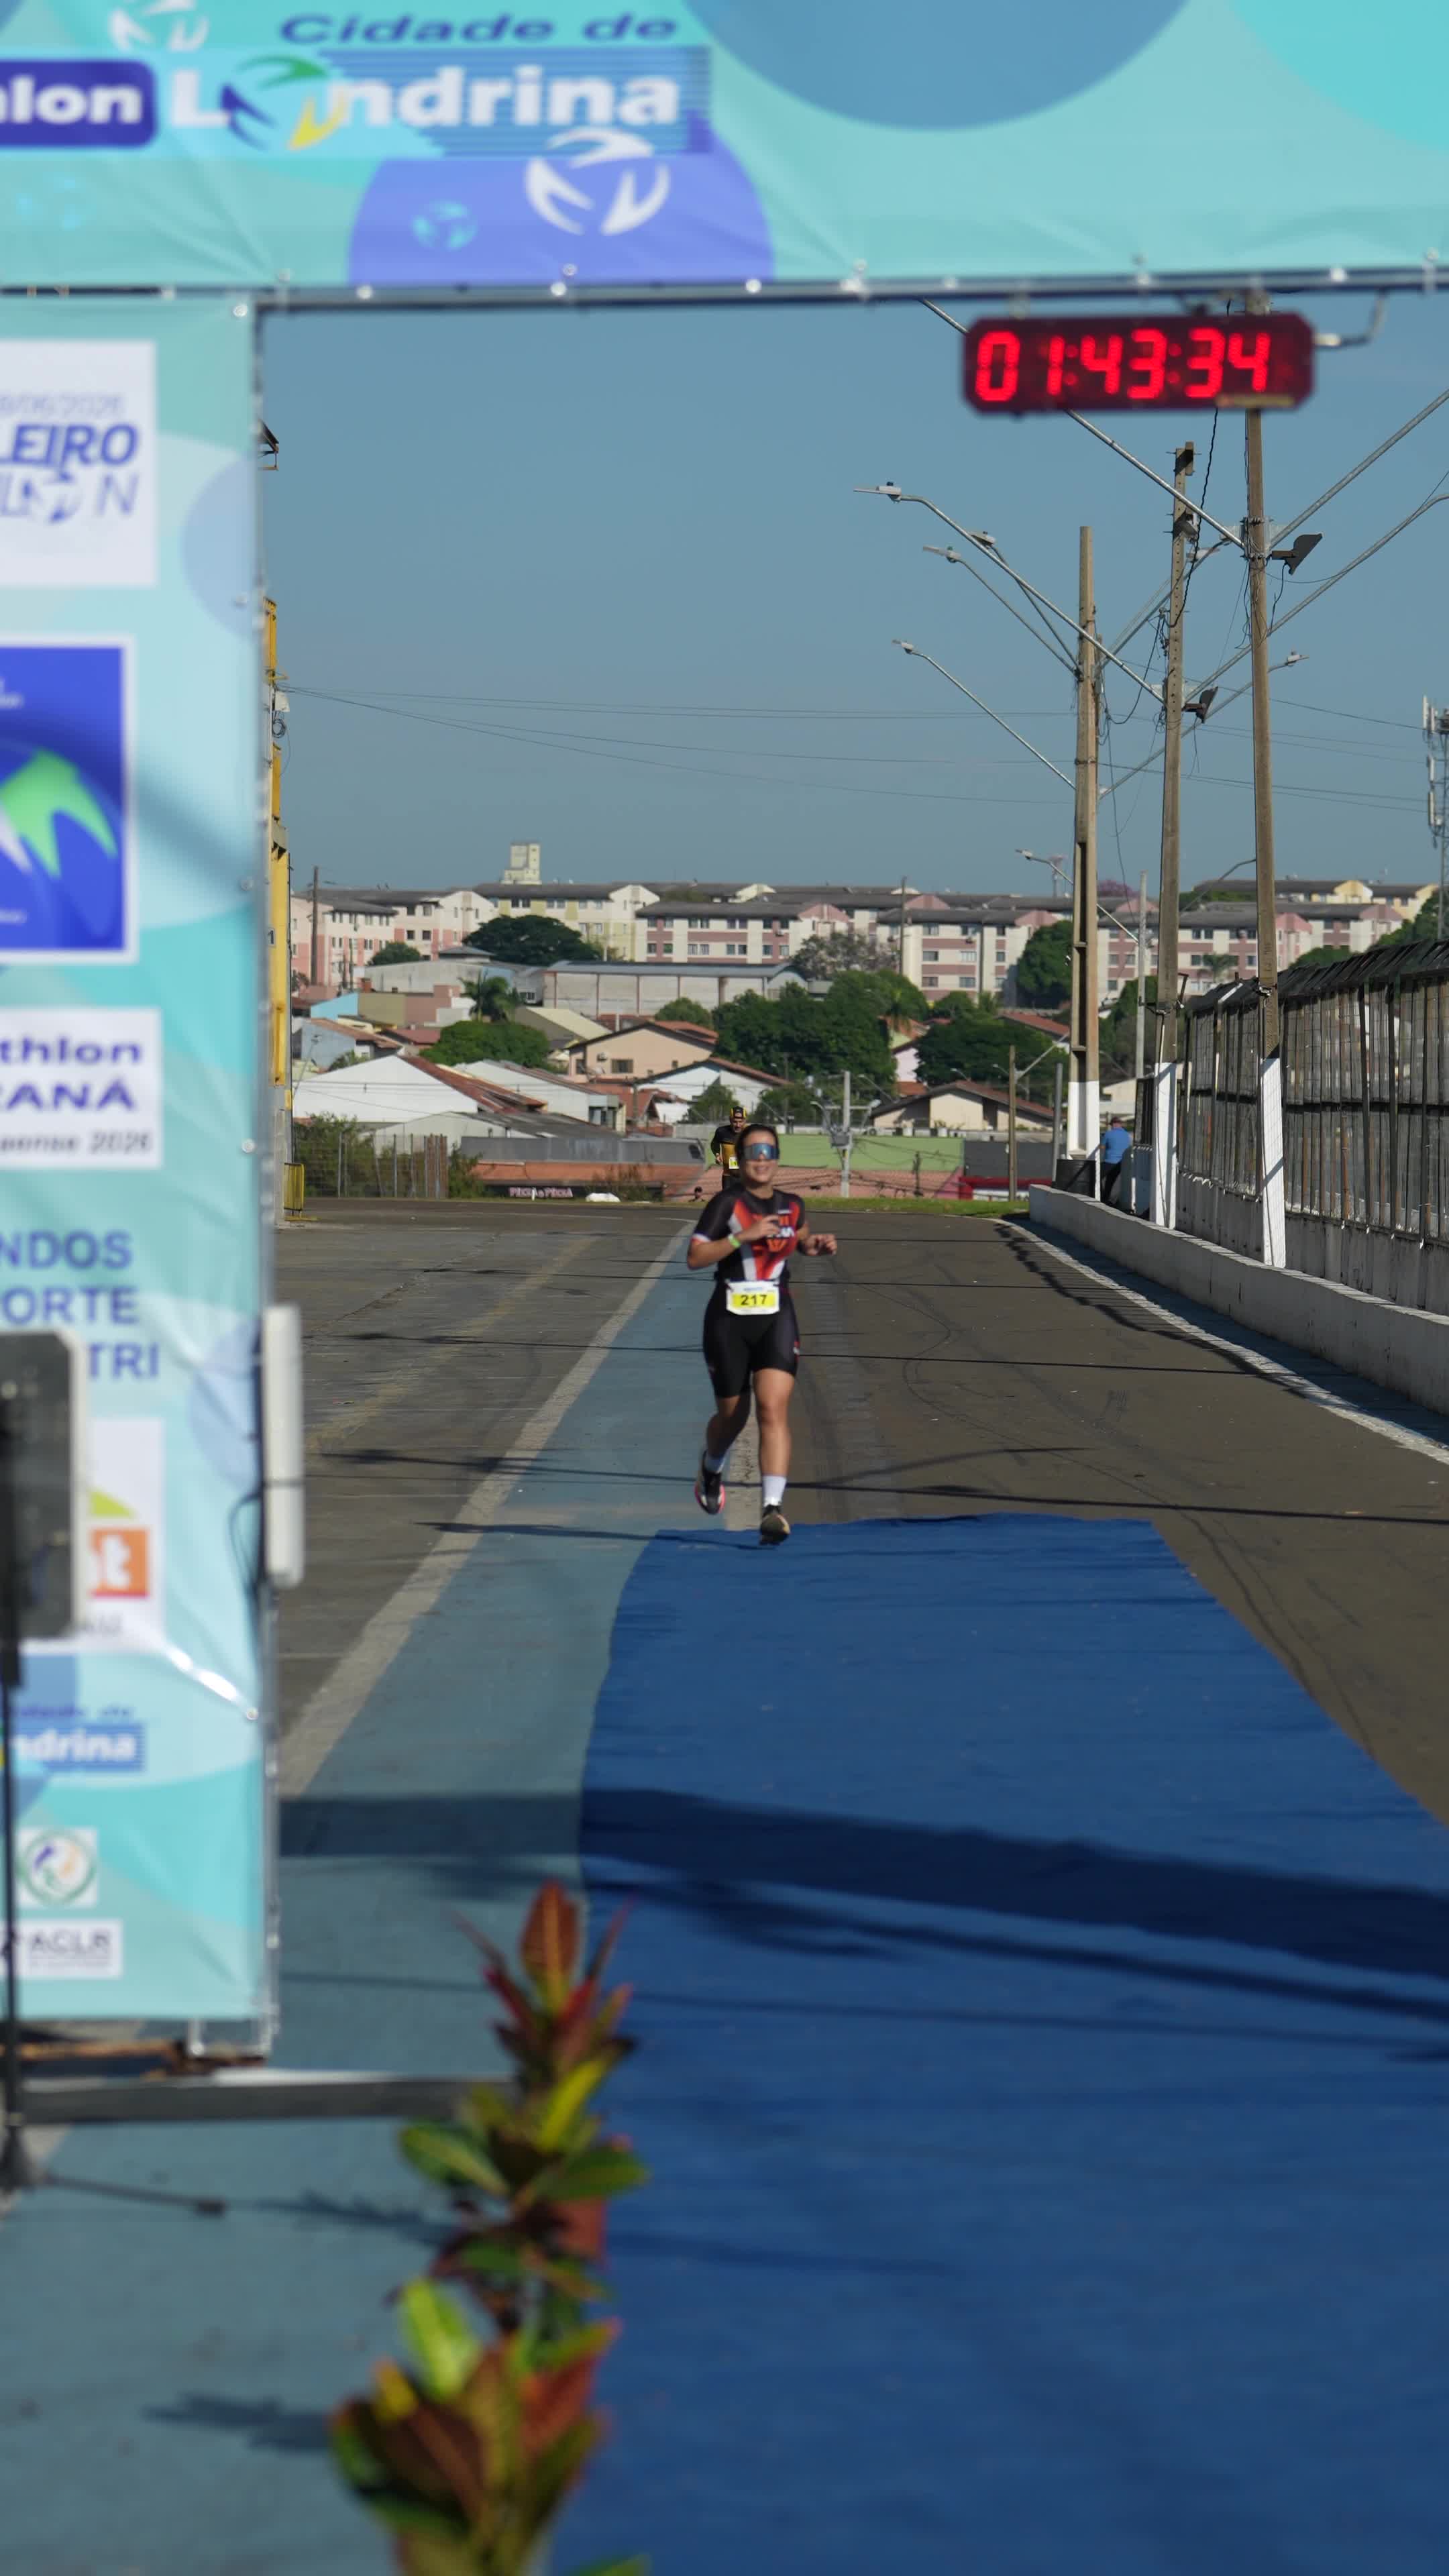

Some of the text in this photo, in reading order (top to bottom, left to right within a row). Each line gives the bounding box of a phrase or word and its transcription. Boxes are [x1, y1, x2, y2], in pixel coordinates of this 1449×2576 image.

[279, 15, 679, 44] Cidade de
[975, 329, 1271, 401] 01:43:34
[0, 1078, 136, 1110] ANÁ
[1, 1287, 140, 1326] ORTE
[740, 1294, 767, 1306] 217
[89, 1343, 160, 1379] TRI
